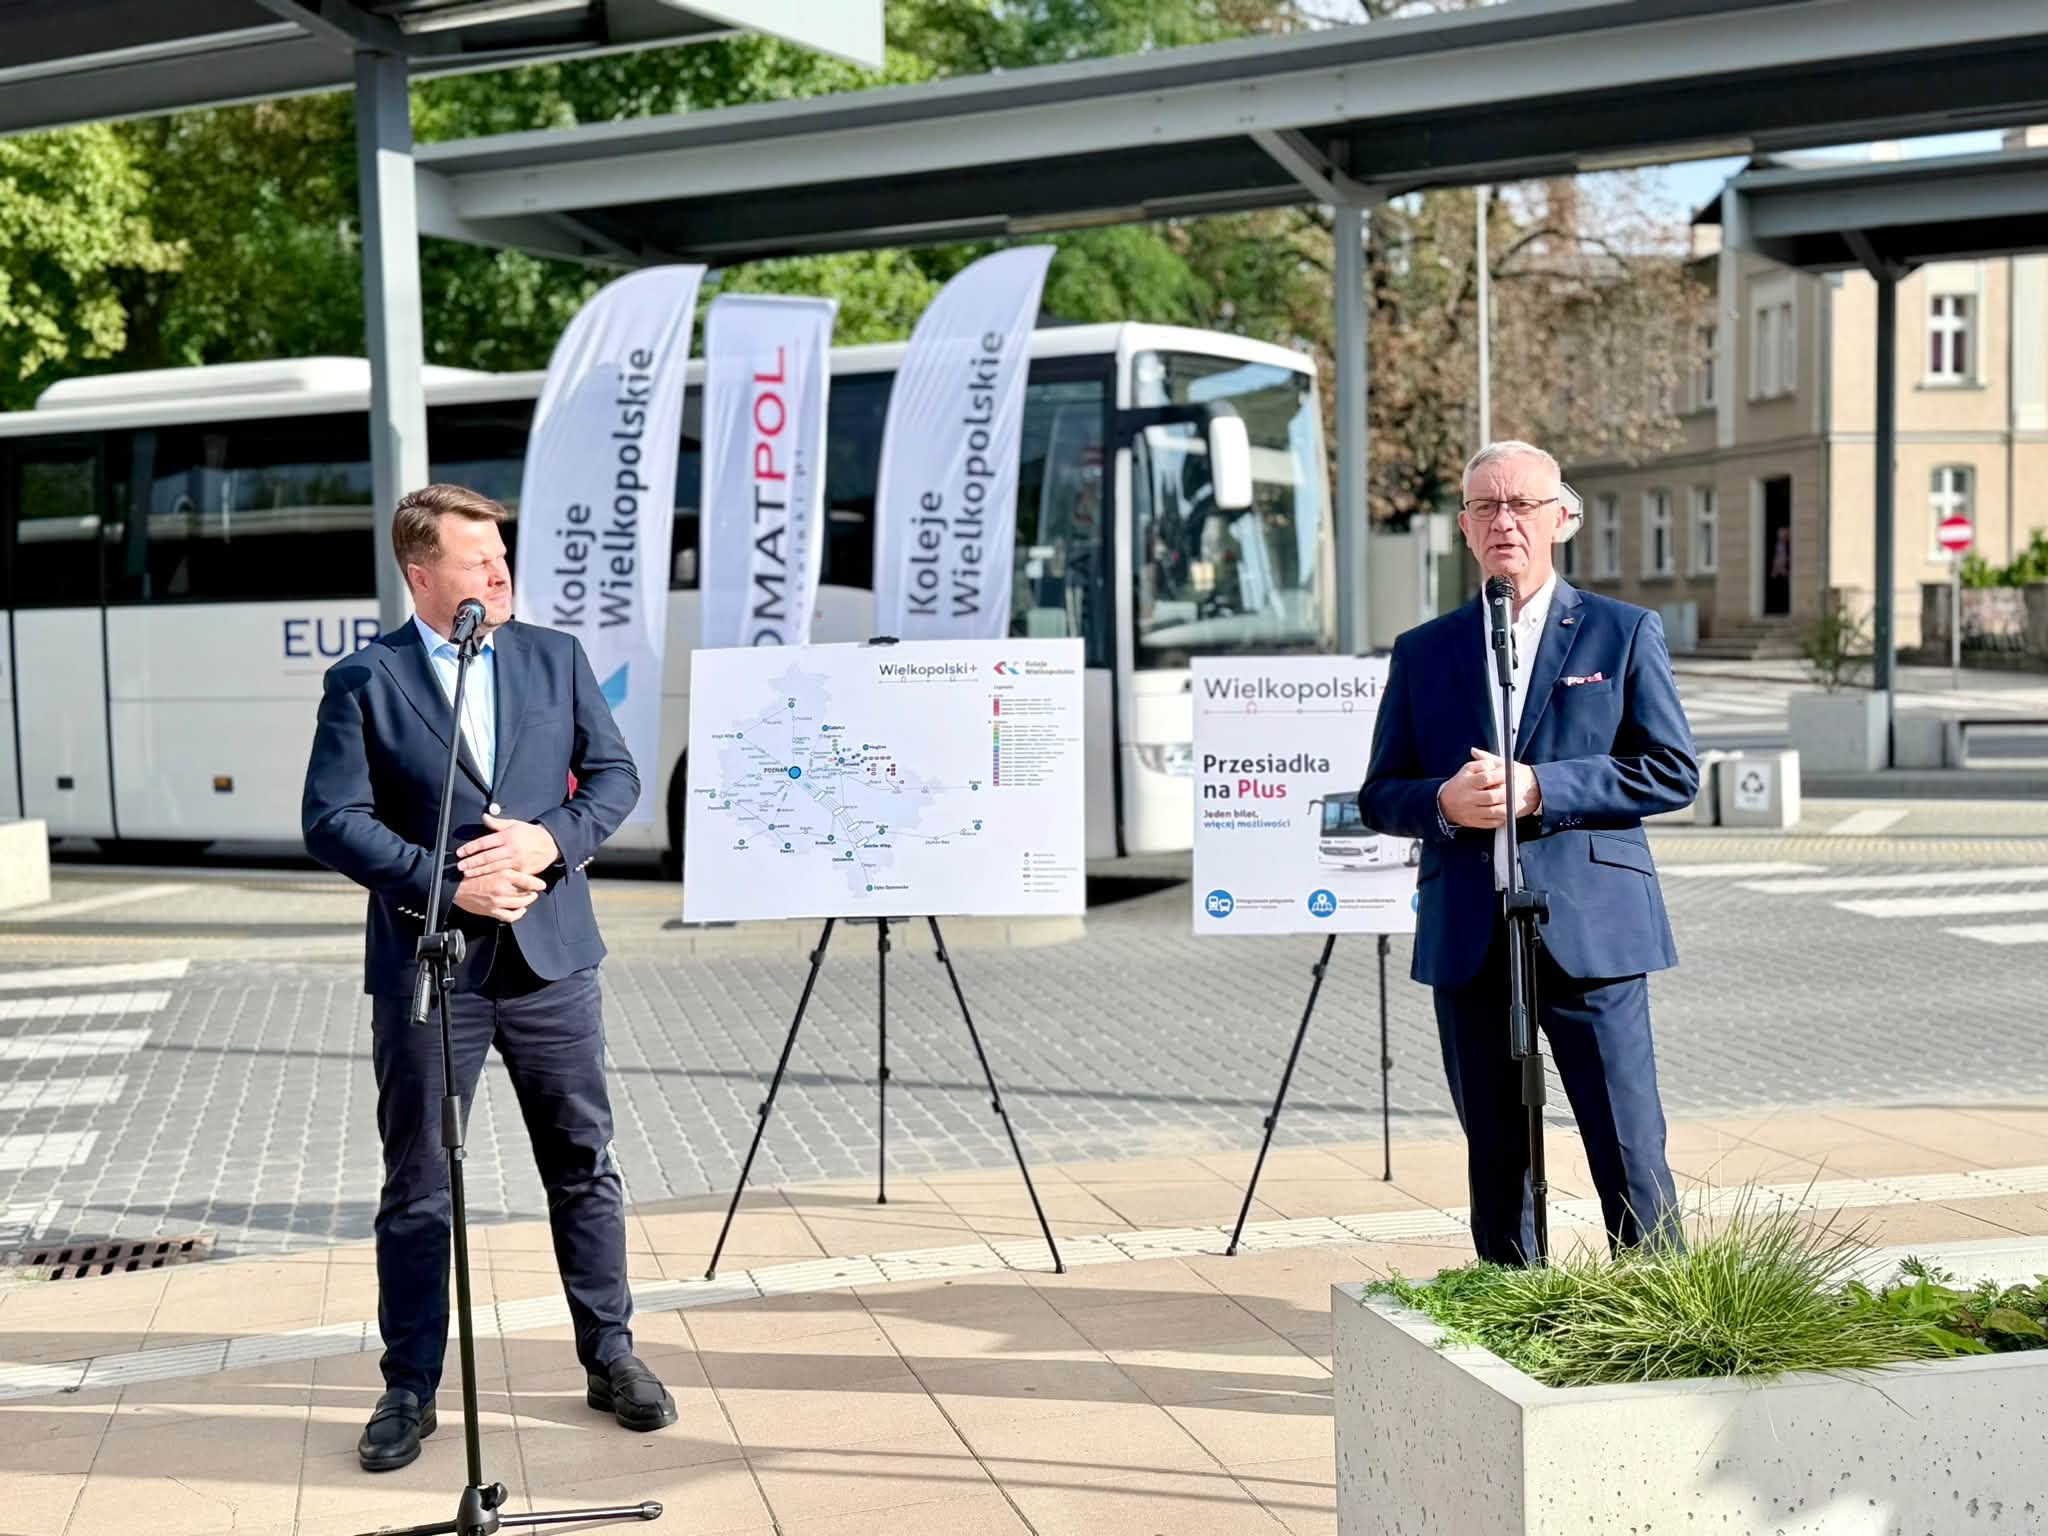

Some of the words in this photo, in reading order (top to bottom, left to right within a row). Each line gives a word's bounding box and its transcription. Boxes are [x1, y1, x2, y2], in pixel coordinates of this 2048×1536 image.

[951, 331, 1004, 618] Wielkopolskie
[599, 348, 653, 629] Wielkopolskie
[553, 503, 597, 627] Koleje
[908, 490, 948, 615] Koleje
[1203, 677, 1386, 704] Wielkopolski
[1203, 754, 1330, 774] Przesiadka
[1203, 783, 1230, 799] na
[1238, 780, 1287, 799] Plus
[1203, 809, 1232, 818] Jeden
[1203, 820, 1235, 830] więcej
[1237, 818, 1291, 829] możliwości
